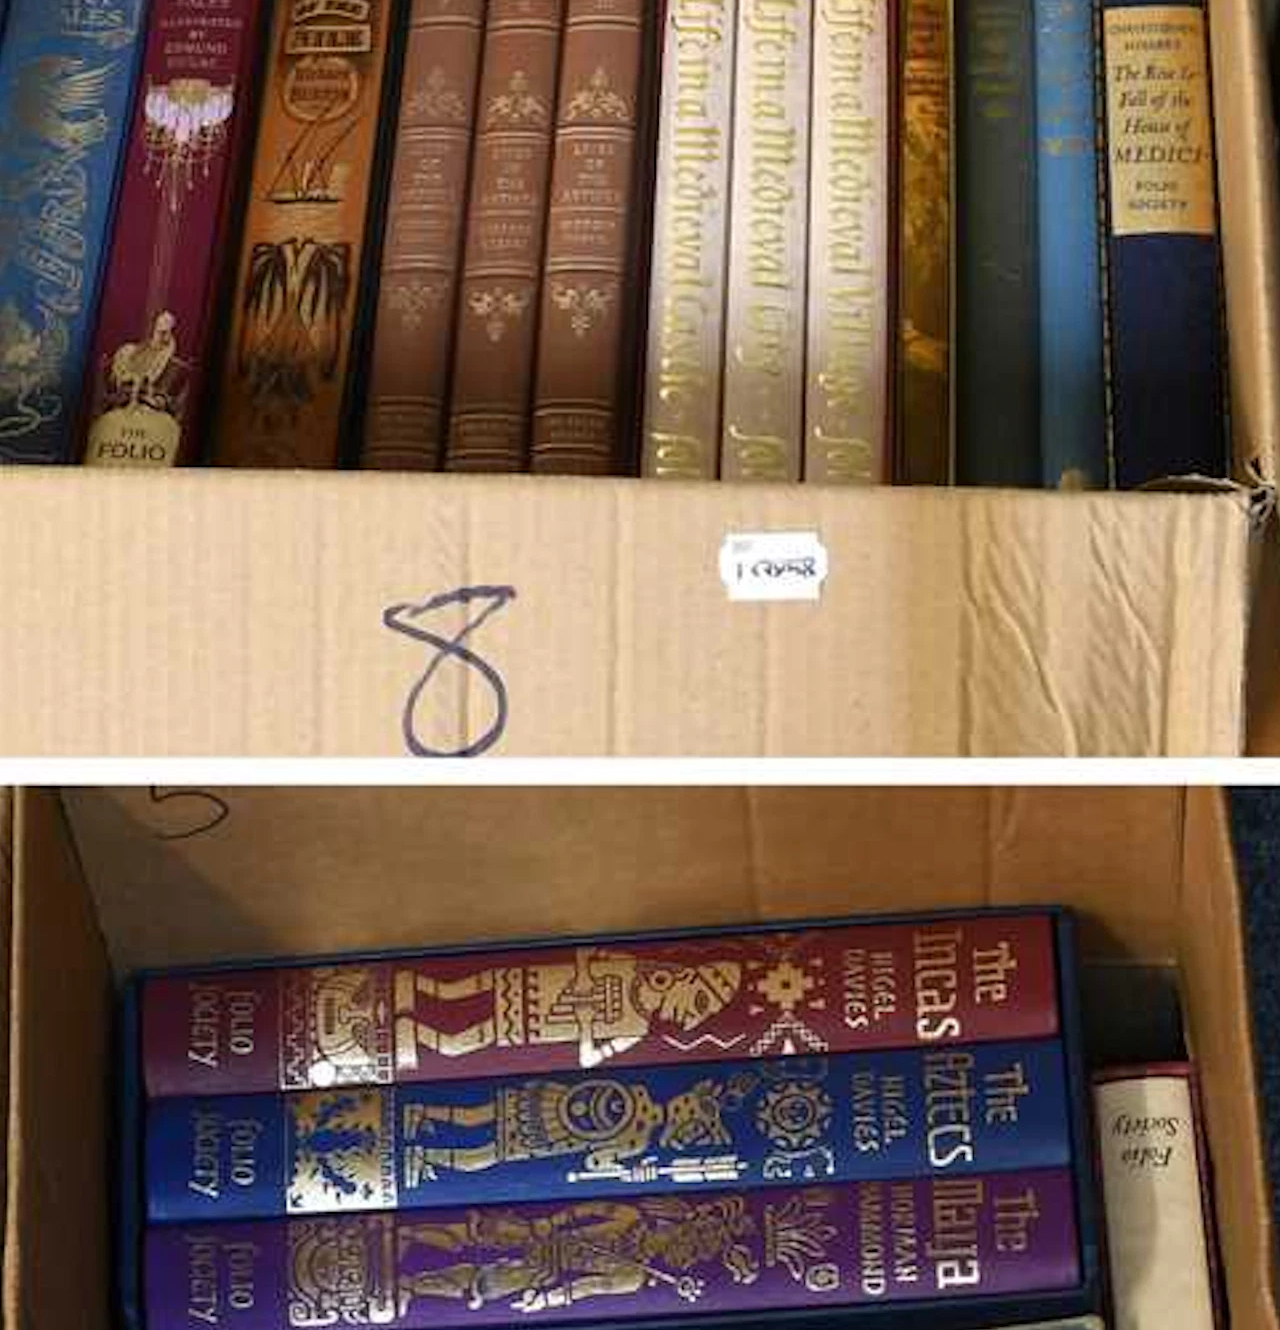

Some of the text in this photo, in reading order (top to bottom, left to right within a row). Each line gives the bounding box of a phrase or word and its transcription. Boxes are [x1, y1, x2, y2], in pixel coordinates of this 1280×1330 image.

[1114, 65, 1141, 82] The
[670, 126, 721, 287] Medieval
[750, 126, 796, 289] Medieval
[827, 118, 875, 274] Medieval
[96, 440, 168, 462] FOLIO
[382, 584, 517, 757] 8
[972, 939, 1019, 1005] The
[229, 990, 260, 1057] FOLIO
[983, 1062, 1030, 1126] The
[1111, 1115, 1178, 1137] Society
[226, 1118, 262, 1187] FOLIO
[1120, 1143, 1171, 1166] Folio
[992, 1187, 1041, 1254] The
[225, 1242, 261, 1310] FOLIO
